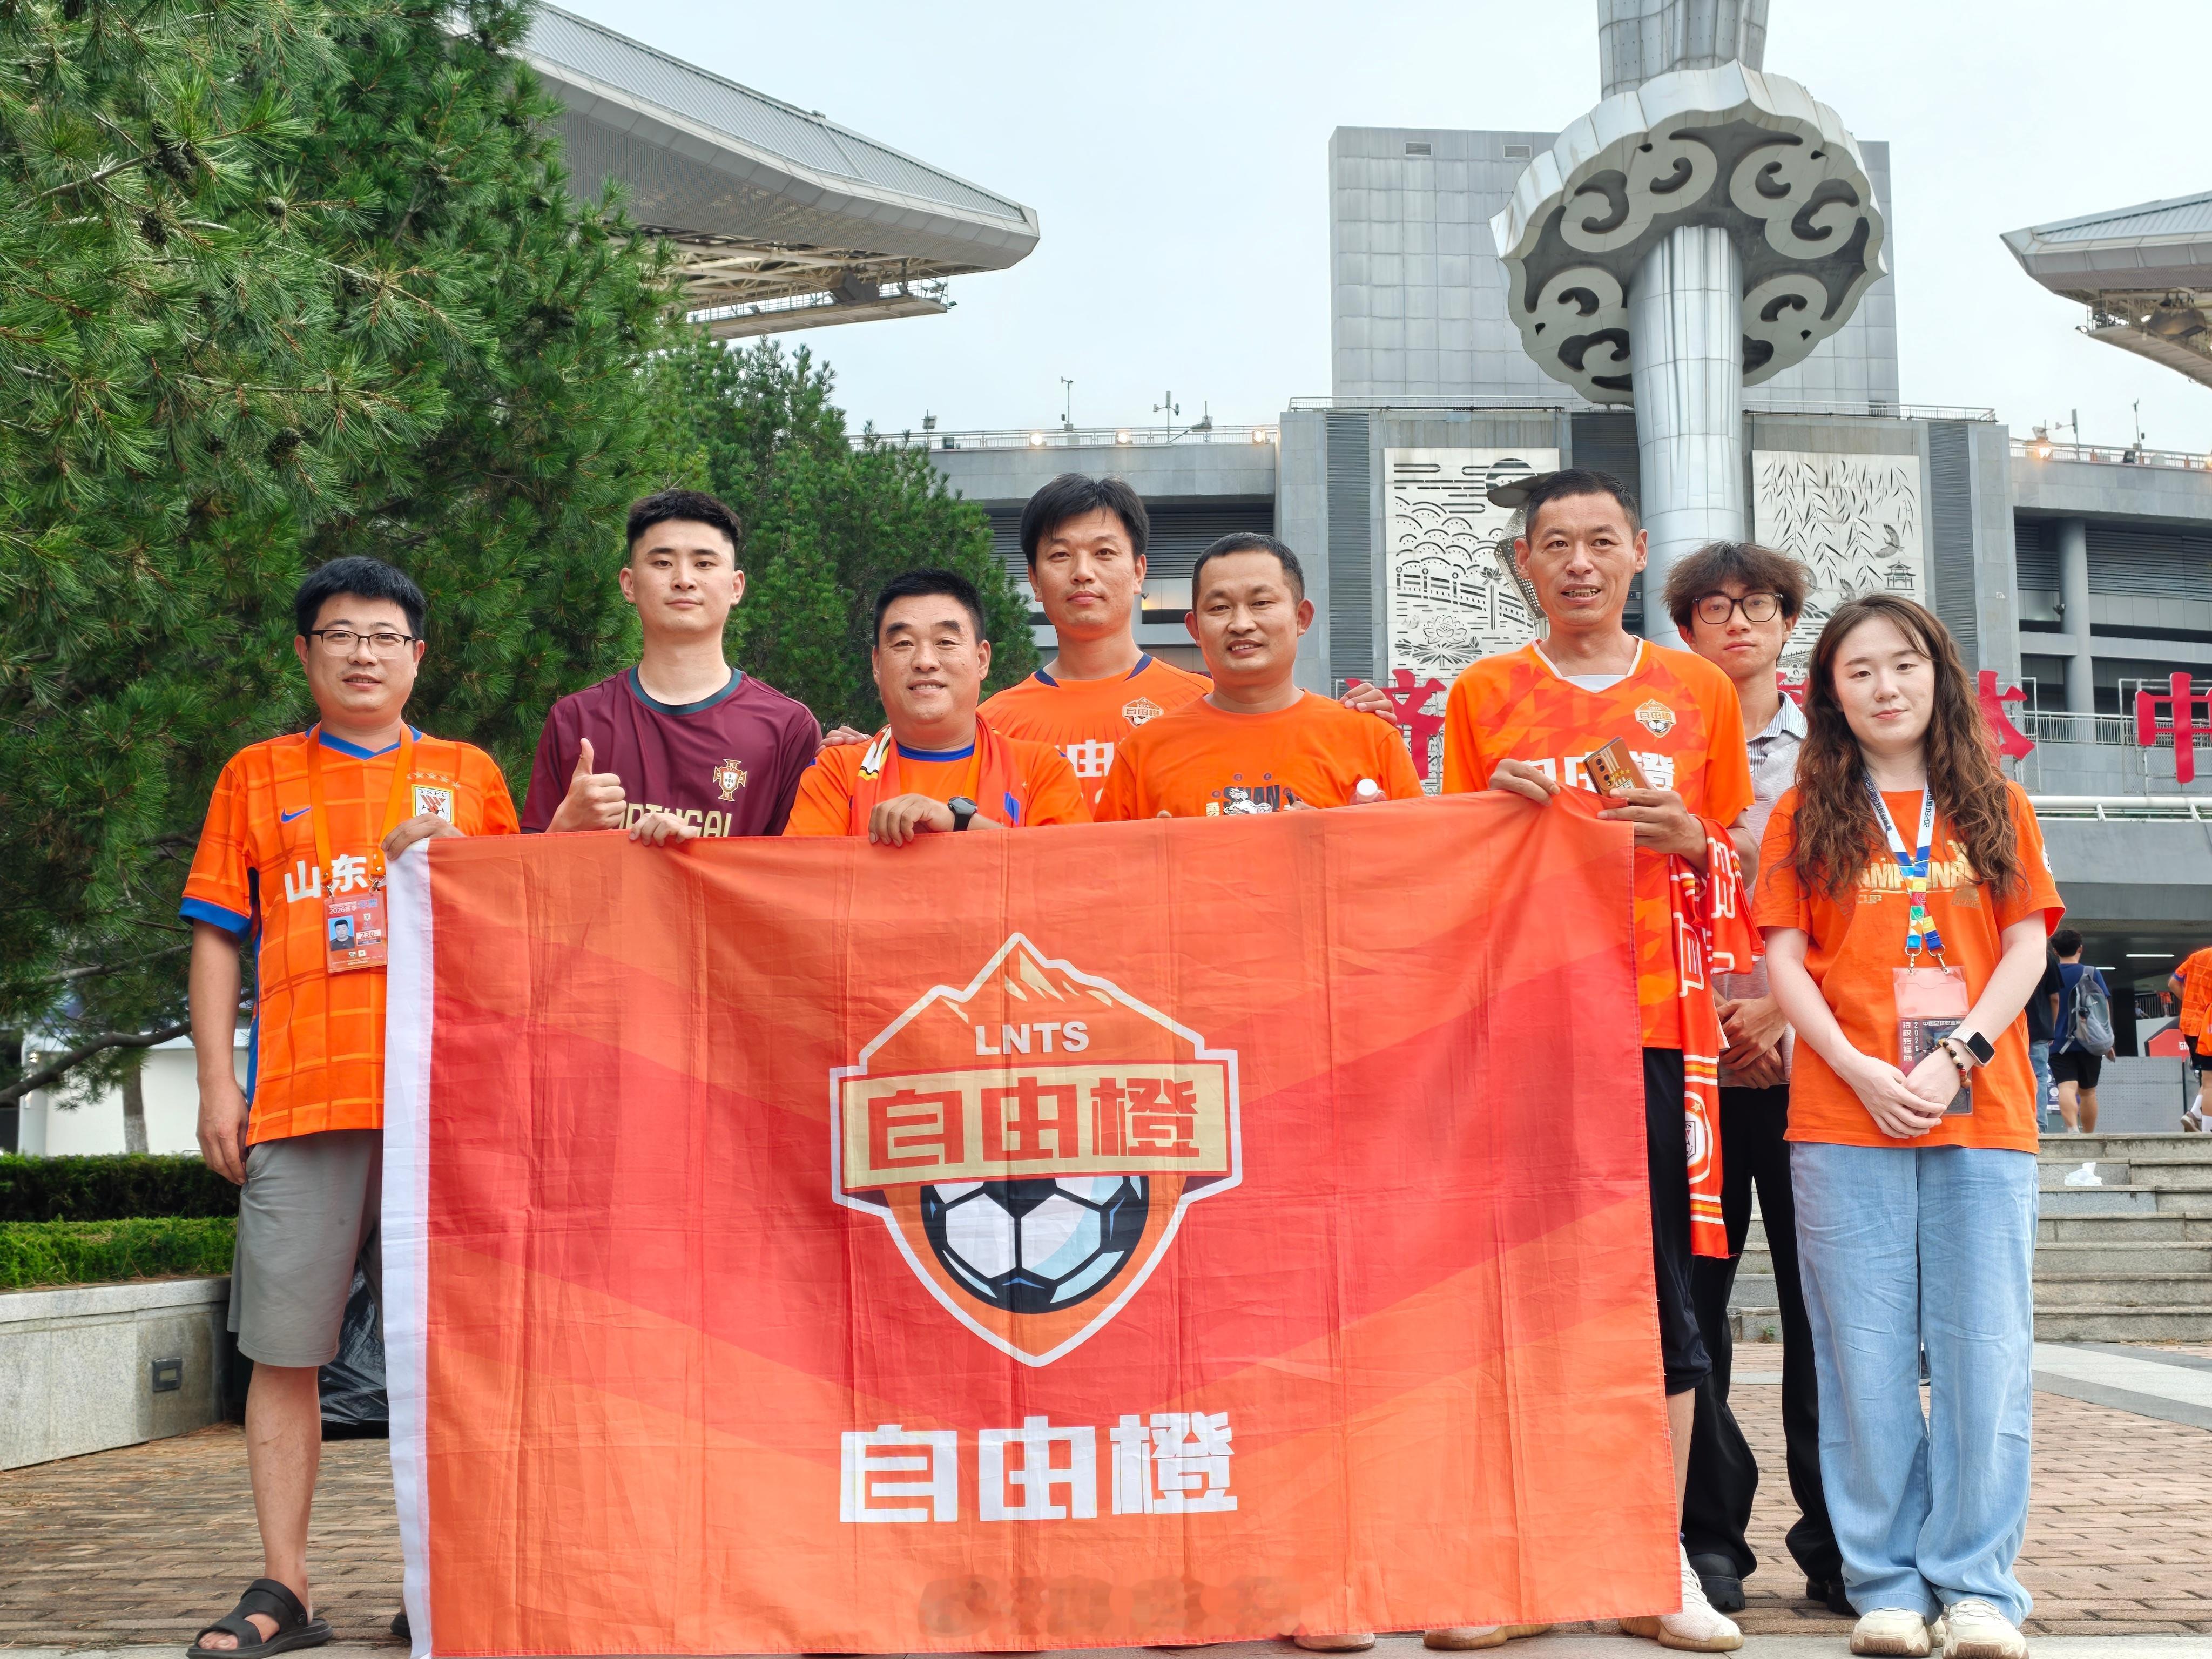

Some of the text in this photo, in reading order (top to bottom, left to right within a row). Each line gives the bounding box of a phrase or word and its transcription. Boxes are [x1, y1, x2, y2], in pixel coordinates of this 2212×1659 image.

[284, 854, 370, 903] 山东
[975, 1021, 1089, 1056] LNTS
[867, 1076, 1200, 1171] 自由橙
[839, 1412, 1238, 1523] 自由橙
